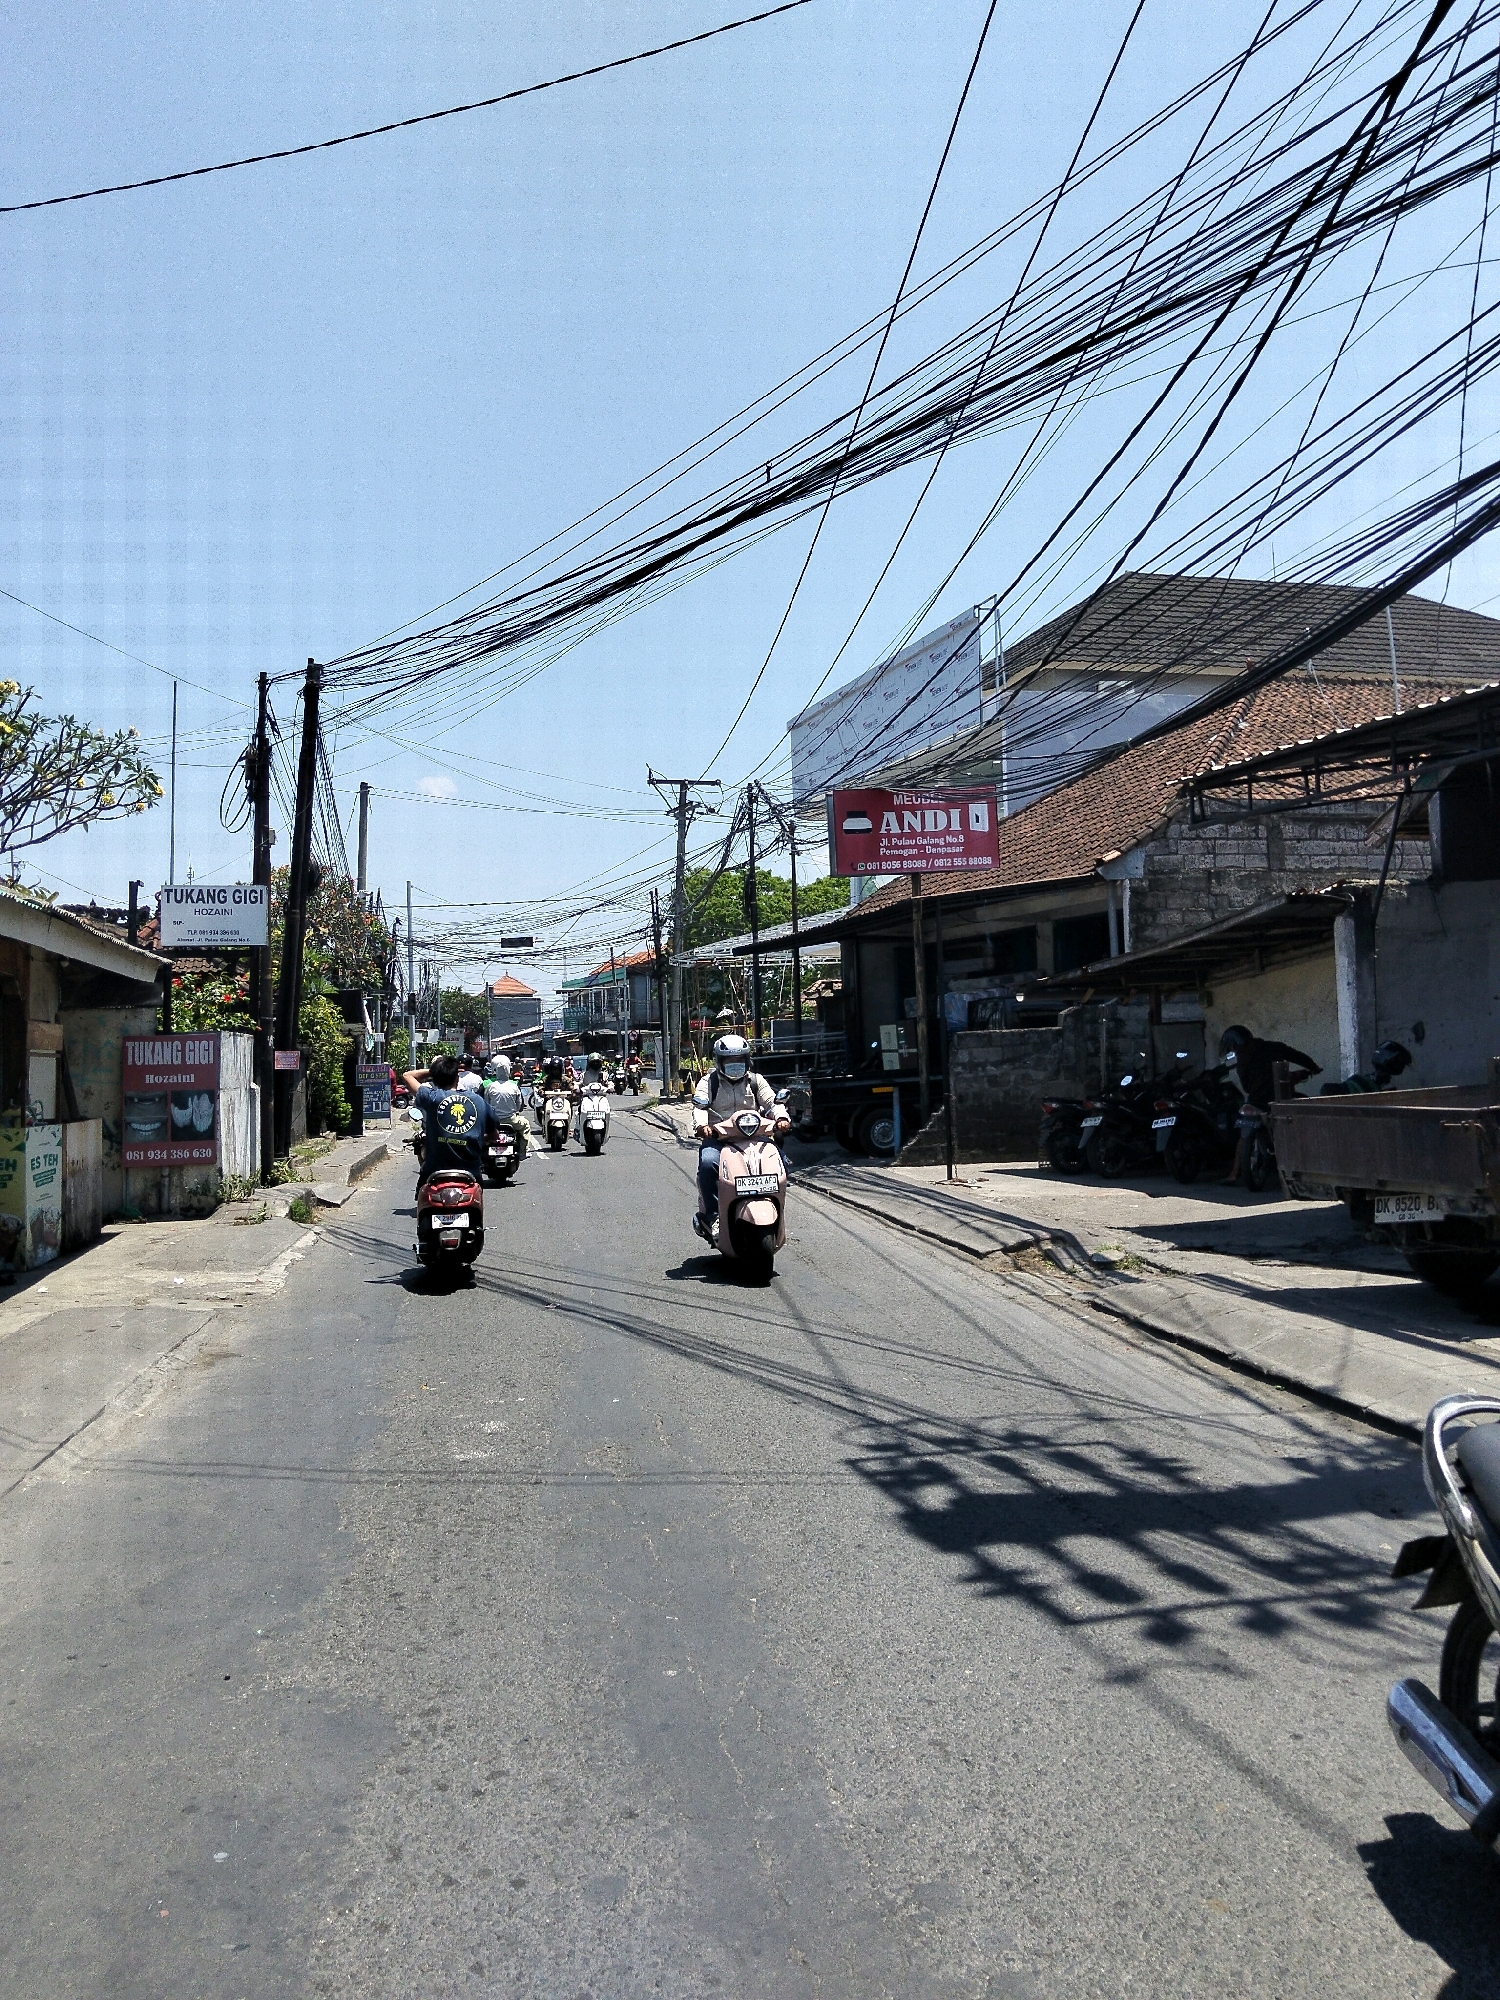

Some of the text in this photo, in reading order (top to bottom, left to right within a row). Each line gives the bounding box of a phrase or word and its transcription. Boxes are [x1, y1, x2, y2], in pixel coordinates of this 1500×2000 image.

[879, 808, 962, 834] ANDI
[880, 834, 964, 847] Jl. Pulau Galang No.8
[880, 847, 918, 856] Pemogan
[926, 846, 965, 855] Denpasar
[867, 862, 880, 870] 081
[881, 861, 901, 870] 8056
[934, 859, 952, 868] 0812
[954, 858, 966, 866] 555
[164, 888, 264, 904] TUKANG GIGI
[126, 1040, 214, 1066] TUKANG GIGI
[145, 1074, 195, 1084] Hozaini
[126, 1148, 212, 1160] 081 934 386 630
[31, 1156, 40, 1171] ES
[43, 1154, 58, 1166] TEH
[1376, 1198, 1389, 1213] DK
[1395, 1196, 1420, 1212] 8520
